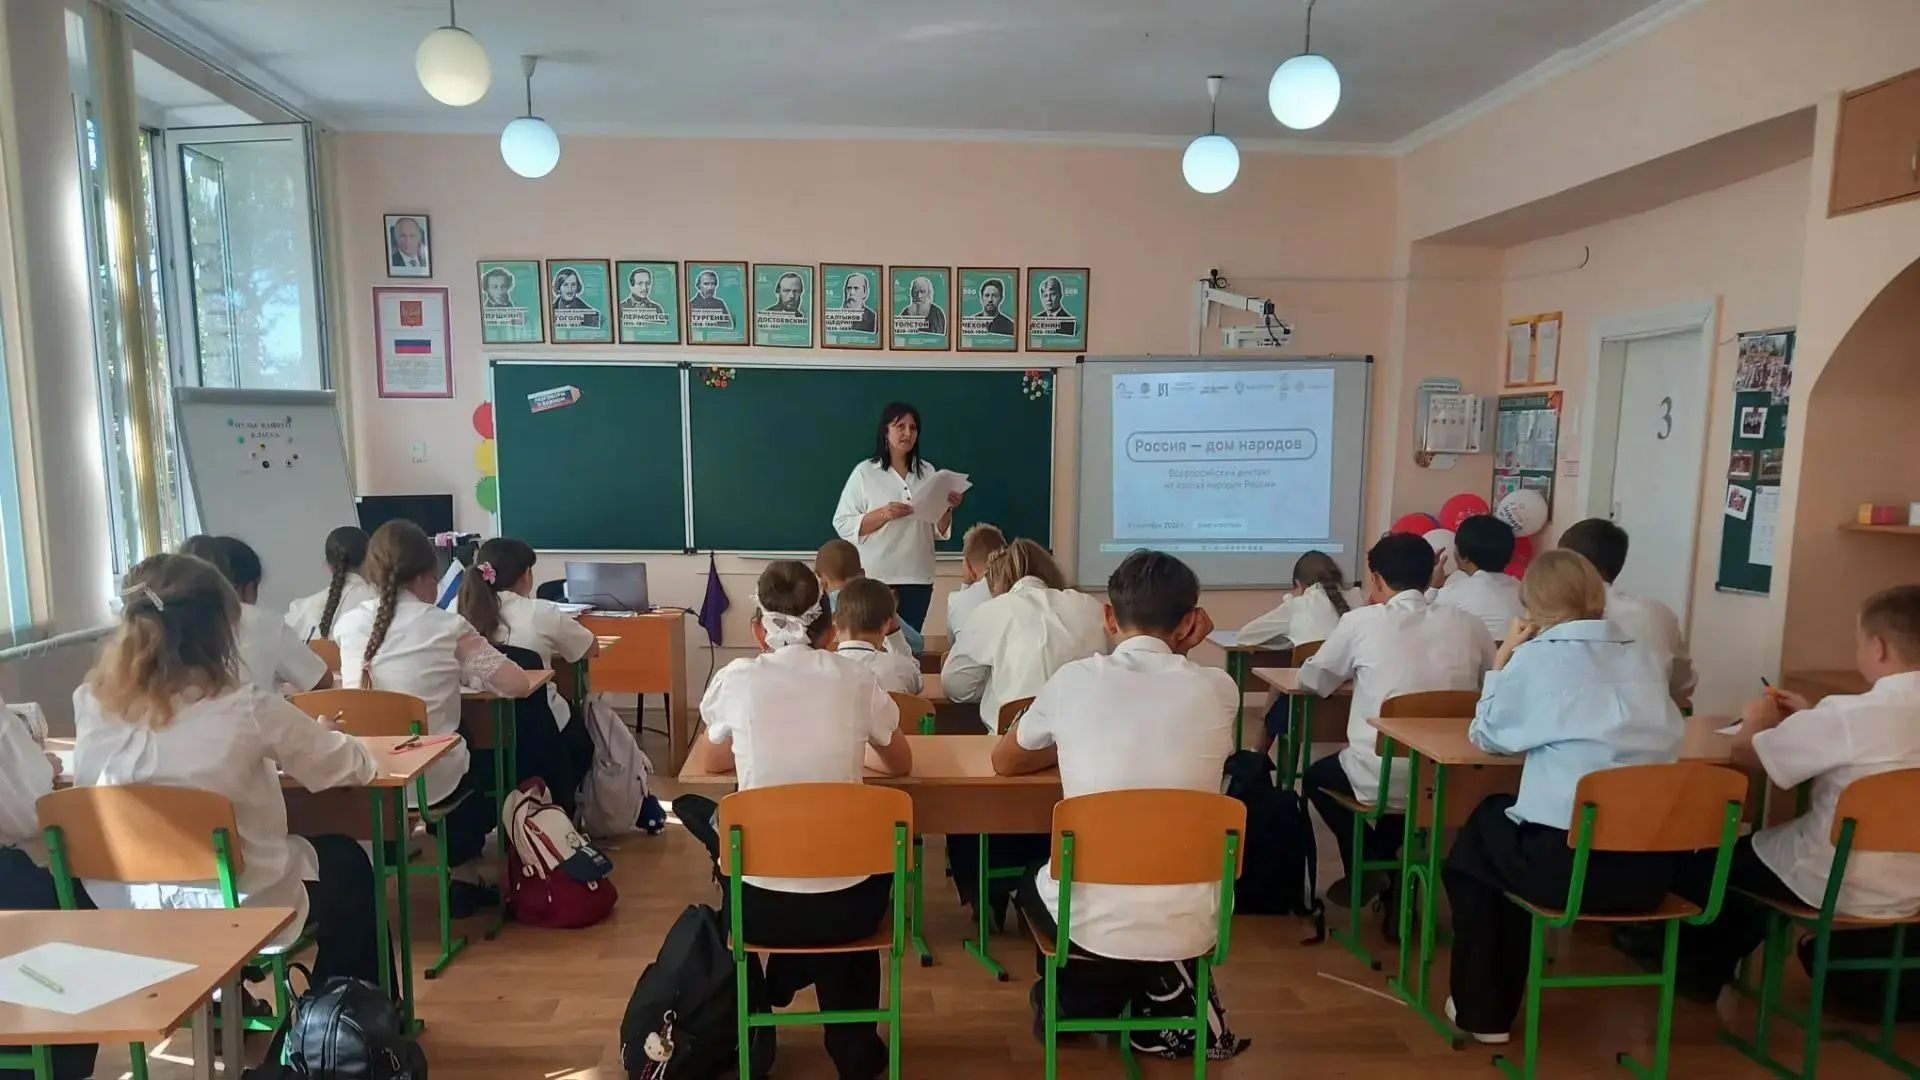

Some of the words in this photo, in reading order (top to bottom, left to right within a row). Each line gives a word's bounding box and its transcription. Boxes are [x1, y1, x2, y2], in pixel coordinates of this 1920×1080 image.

[485, 312, 521, 320] ПУШКИН
[757, 316, 808, 324] ДОСТОЕВСКИЙ
[1135, 439, 1186, 452] Россия
[1206, 440, 1235, 453] дом
[1239, 439, 1302, 453] народов
